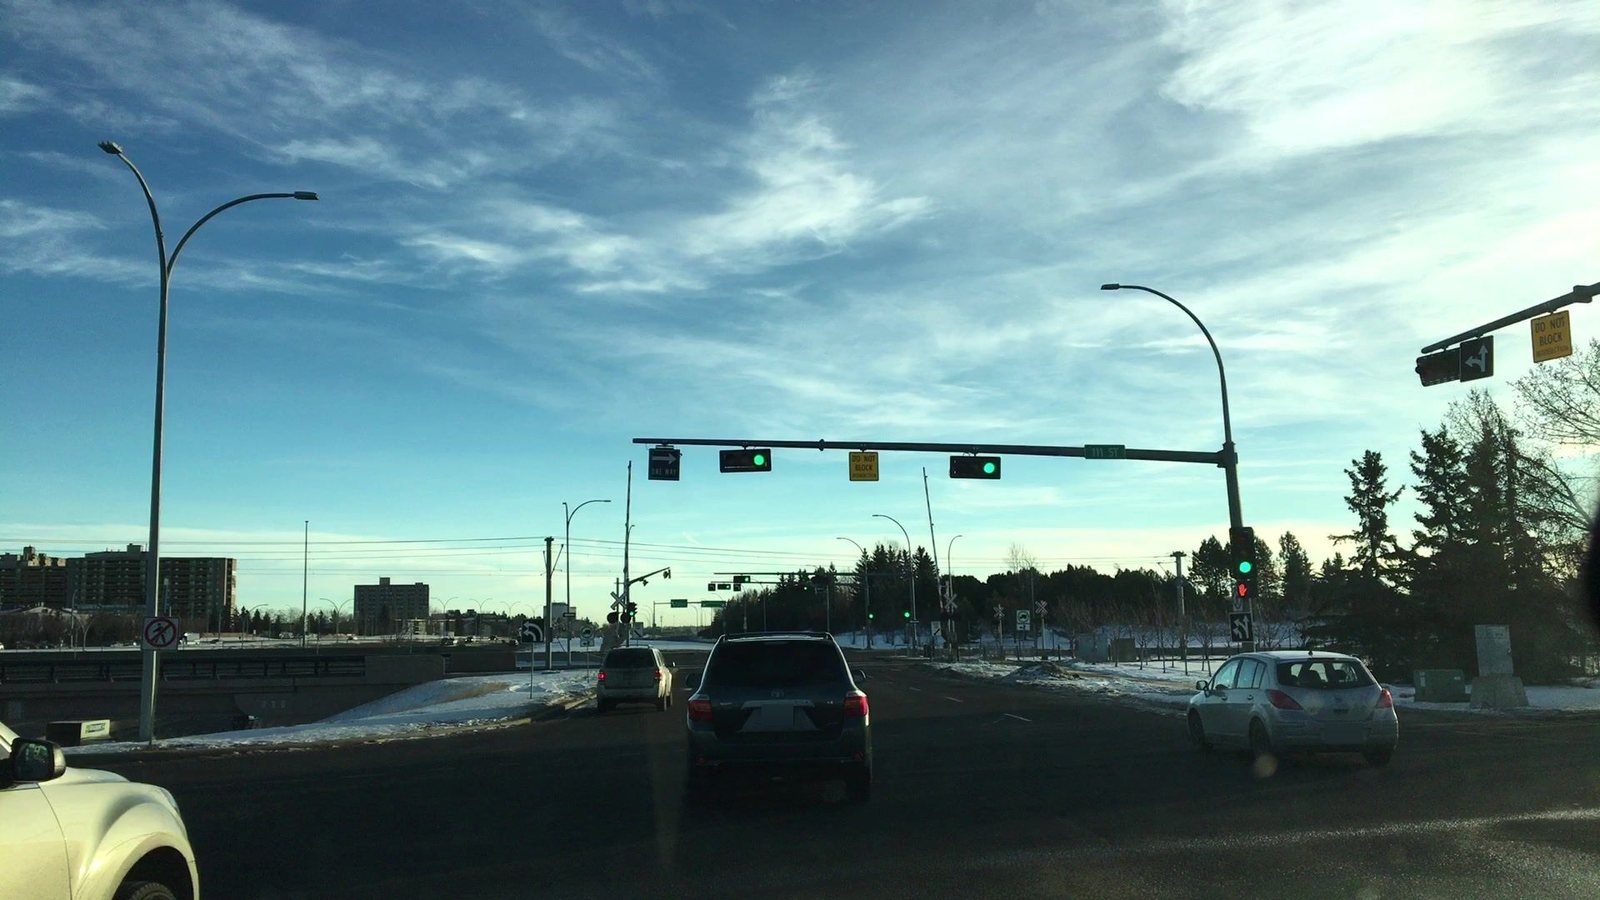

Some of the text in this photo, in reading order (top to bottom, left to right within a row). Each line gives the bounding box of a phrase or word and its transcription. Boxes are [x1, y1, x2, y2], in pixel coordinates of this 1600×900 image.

[1535, 316, 1565, 333] DO NOT
[1540, 332, 1563, 346] BLOCK
[1108, 447, 1119, 457] ST
[852, 454, 876, 462] DO NOT
[665, 468, 677, 477] WAY
